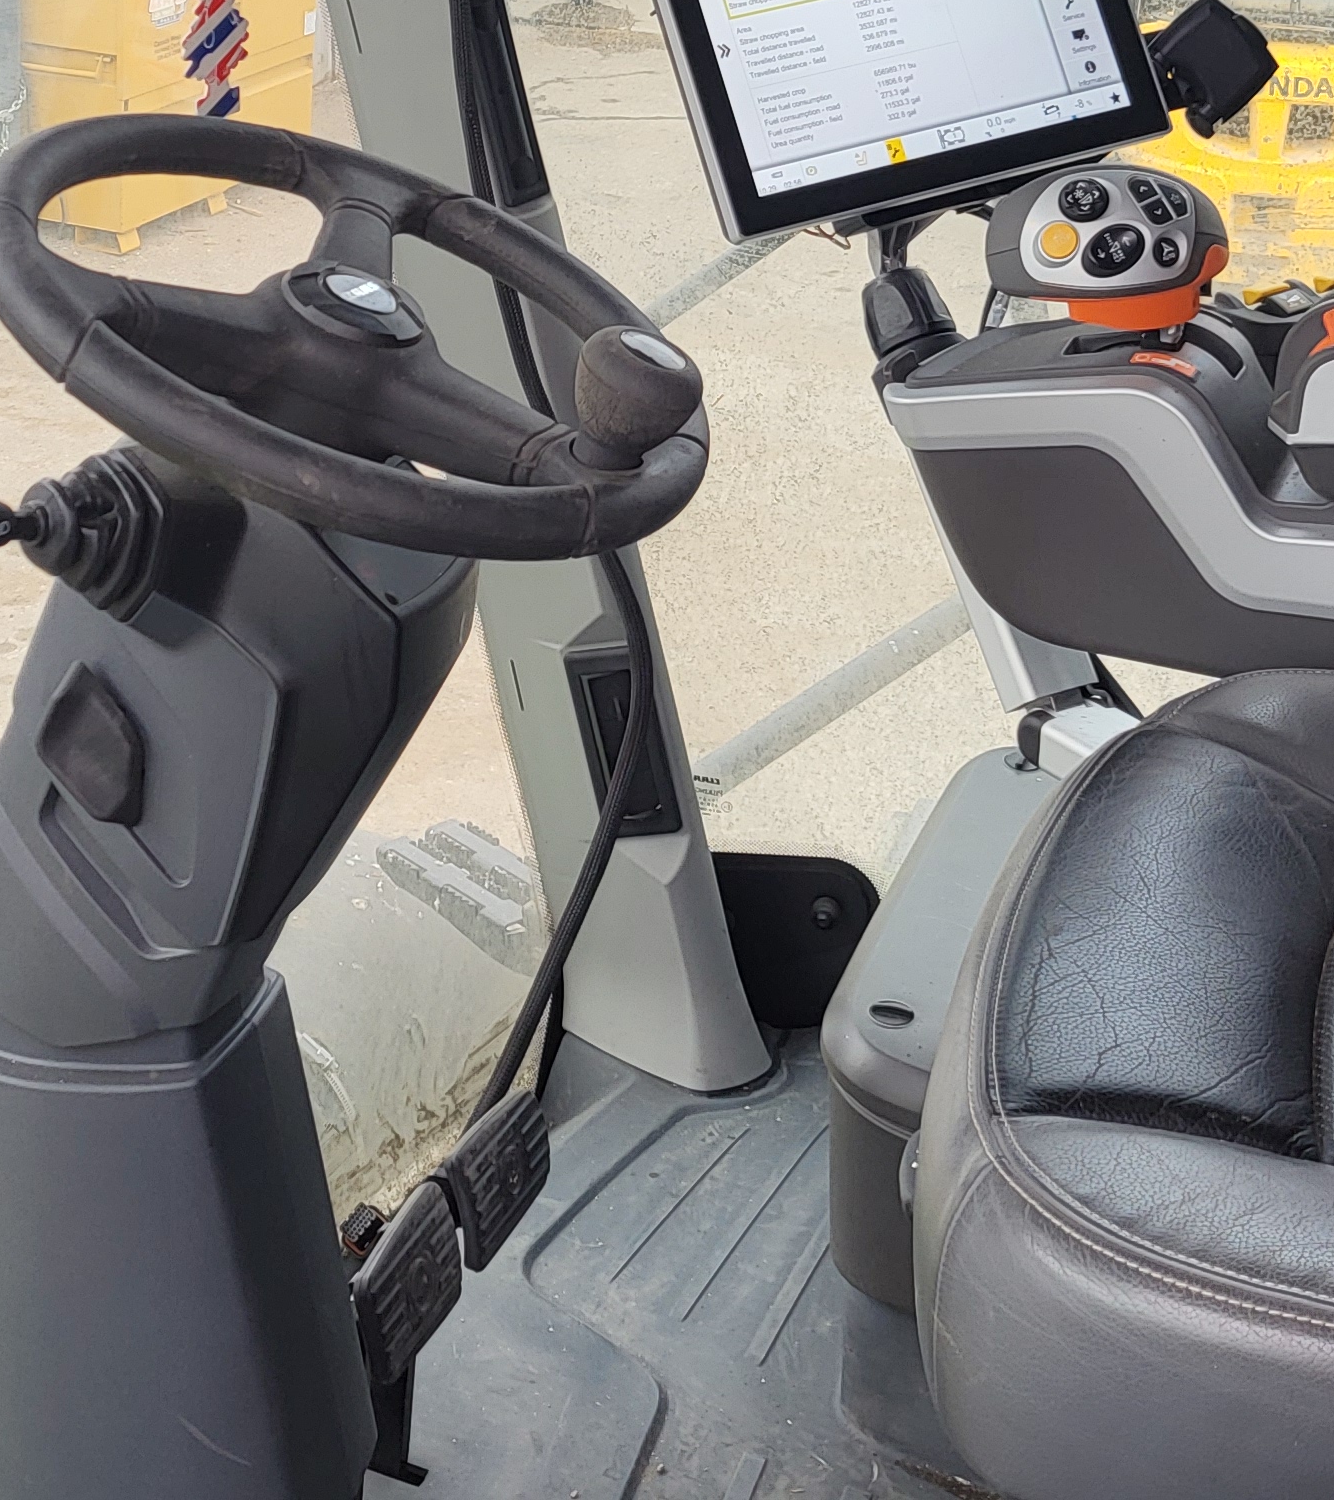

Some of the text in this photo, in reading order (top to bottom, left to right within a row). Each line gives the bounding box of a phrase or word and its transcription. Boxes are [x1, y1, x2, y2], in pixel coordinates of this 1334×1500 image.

[728, 2, 748, 10] Straw
[1062, 12, 1085, 22] Service
[737, 27, 753, 35] Area
[739, 27, 805, 46] Straw chopping area
[742, 34, 816, 57] Total distance travelled
[1072, 44, 1097, 54] Settings
[746, 56, 777, 68] Travelled
[777, 50, 804, 61] distance
[809, 44, 825, 54] road
[749, 67, 780, 79] Travelled
[781, 62, 808, 72] distance
[812, 56, 827, 65] field
[904, 74, 914, 83] gal
[1078, 75, 1112, 87] Information
[757, 88, 807, 104] Harvested crop
[900, 86, 910, 96] gal
[760, 94, 833, 115] Total fuel consumption
[911, 95, 921, 105] gal
[1075, 99, 1085, 109] -8
[764, 117, 780, 127] Fuel
[780, 109, 821, 123] consumption
[826, 103, 841, 112] road
[907, 108, 917, 118] gal
[768, 128, 783, 138] Fuel
[783, 120, 825, 134] consumption
[829, 114, 843, 123] field
[986, 116, 1002, 128] 0.0
[771, 134, 814, 149] Urea quantity
